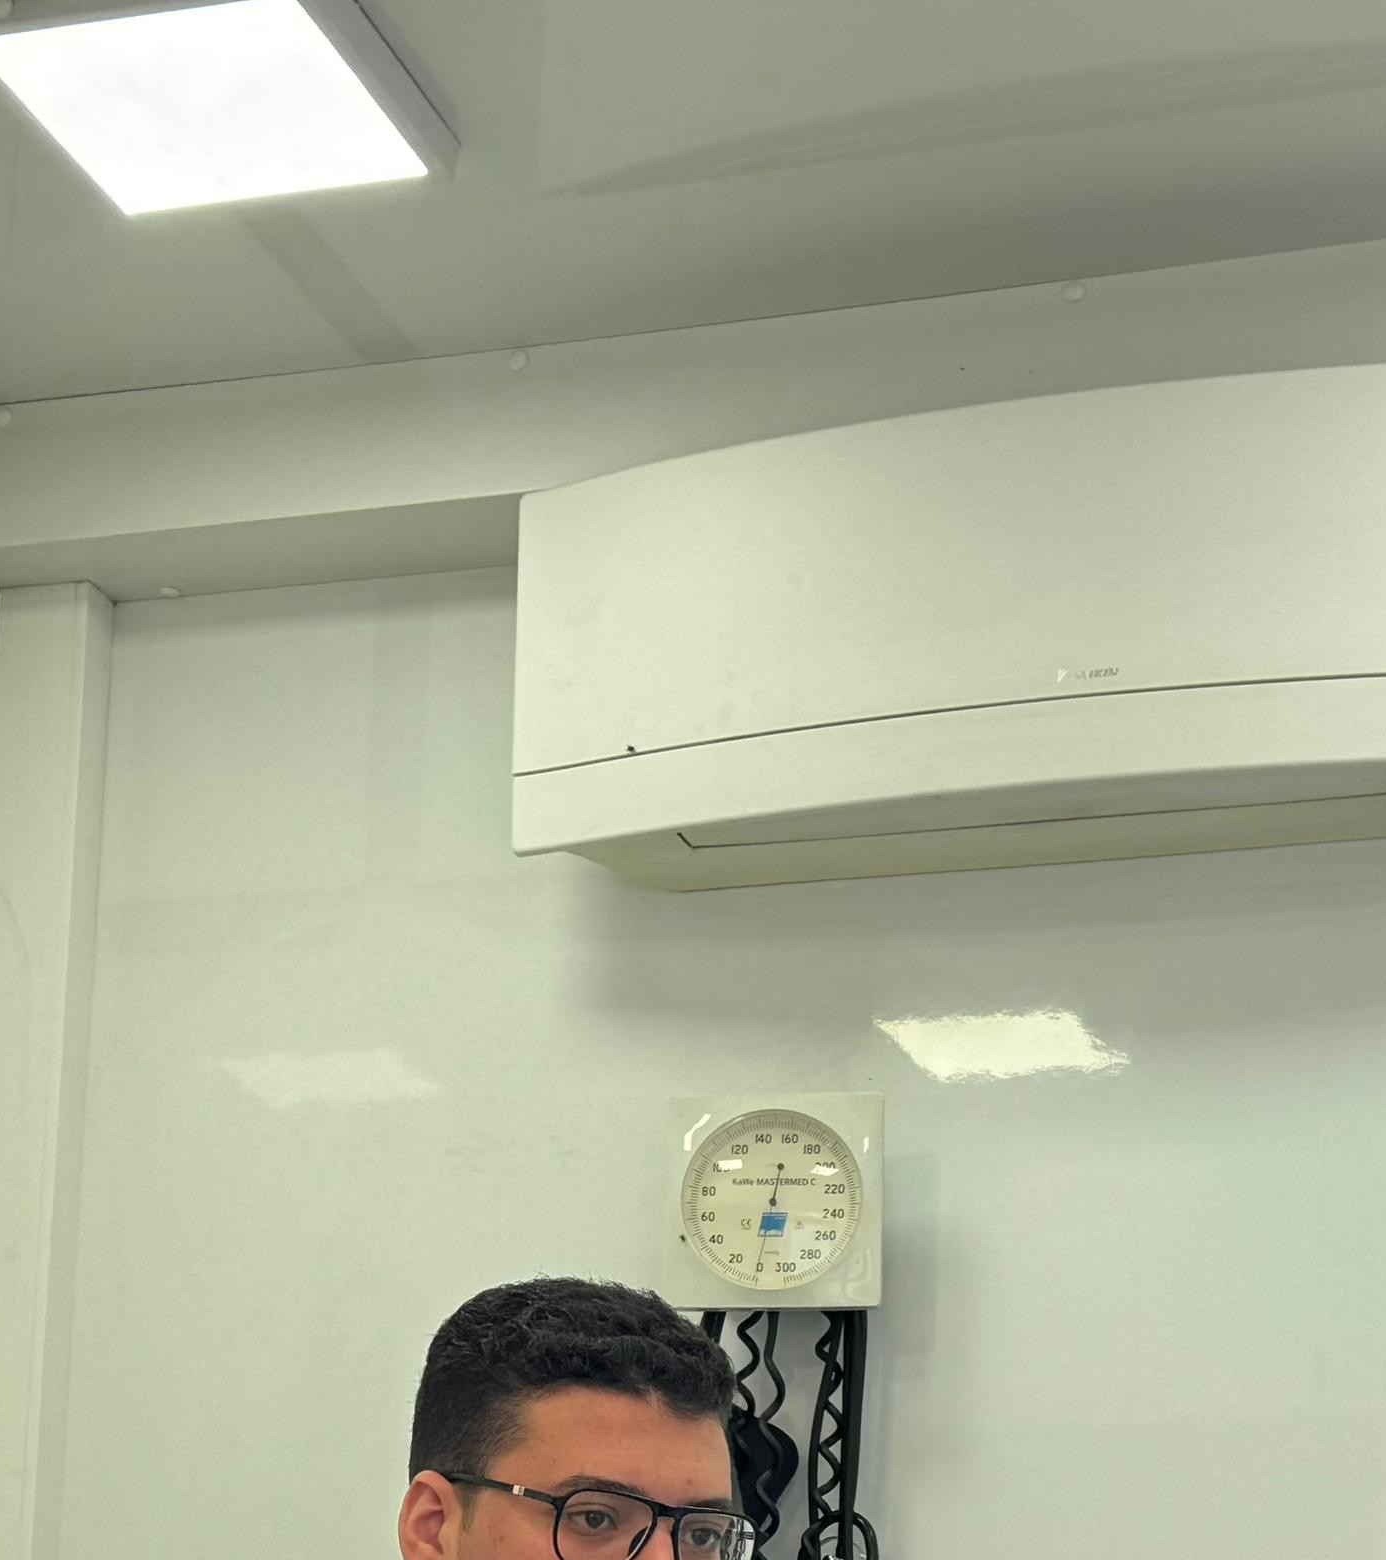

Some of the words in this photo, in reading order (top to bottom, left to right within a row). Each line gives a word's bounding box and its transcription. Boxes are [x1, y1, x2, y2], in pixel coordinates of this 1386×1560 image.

[755, 1134, 772, 1144] 140
[781, 1134, 799, 1144] 160
[731, 1144, 748, 1155] 120
[803, 1144, 821, 1155] 180
[757, 1178, 809, 1186] MASTERMED
[702, 1186, 716, 1197] 80
[824, 1184, 845, 1195] 220
[701, 1211, 716, 1222] 60
[822, 1208, 845, 1219] 240
[709, 1234, 724, 1245] 40
[815, 1230, 836, 1241] 260
[729, 1253, 743, 1264] 20
[800, 1249, 821, 1260] 280
[756, 1262, 764, 1273] 0
[775, 1262, 796, 1273] 300
